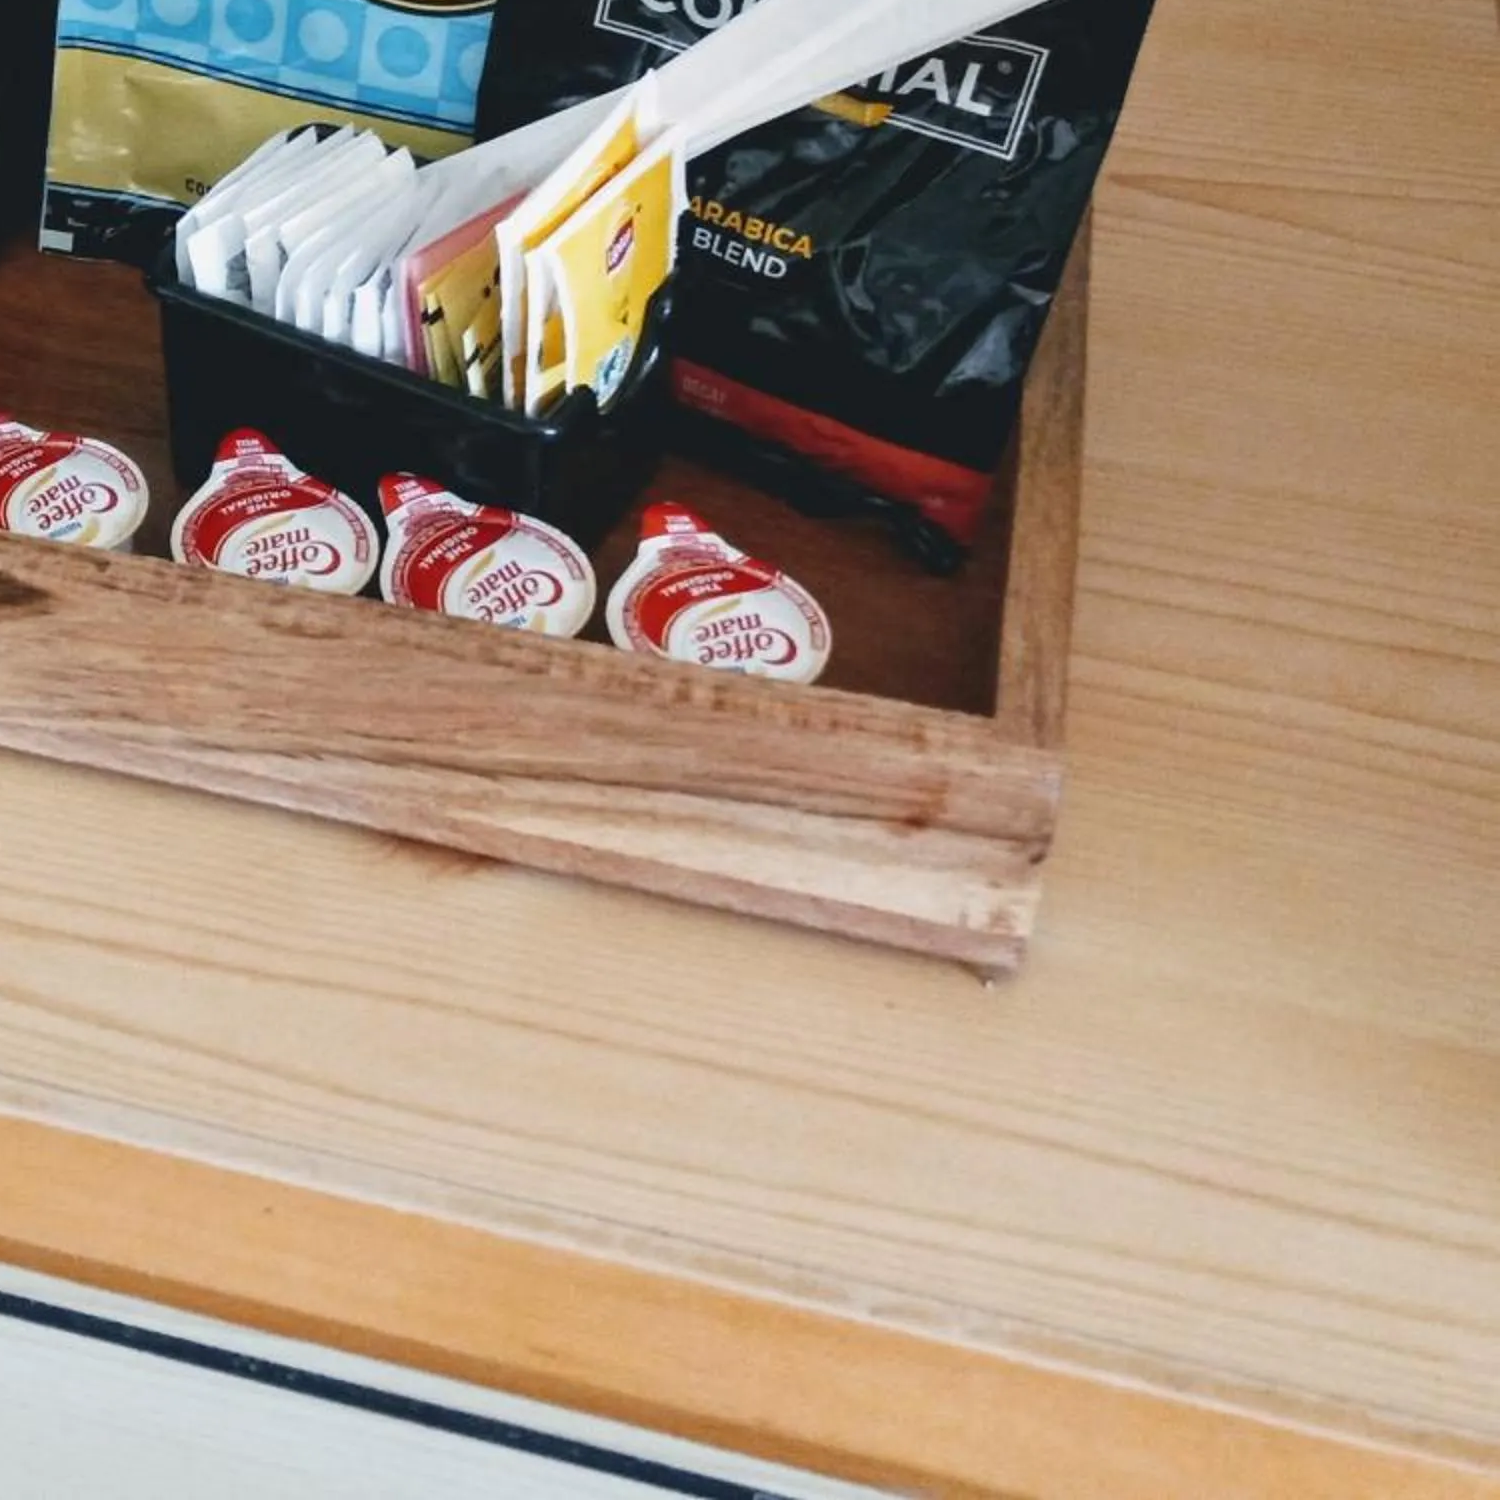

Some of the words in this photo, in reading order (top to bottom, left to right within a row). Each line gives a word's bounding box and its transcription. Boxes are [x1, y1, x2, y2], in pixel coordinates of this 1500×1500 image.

[691, 195, 813, 259] ARABICA
[693, 227, 788, 279] BLEND
[30, 475, 82, 513] mate
[37, 482, 119, 531] Coffee
[220, 489, 293, 516] ORIGINAL
[246, 502, 279, 515] THE
[246, 527, 311, 556] mate
[247, 541, 341, 576] Coffee
[467, 560, 523, 603] mate
[476, 569, 563, 622] Coffee
[695, 612, 763, 642] mate
[698, 627, 798, 665] Coffee
